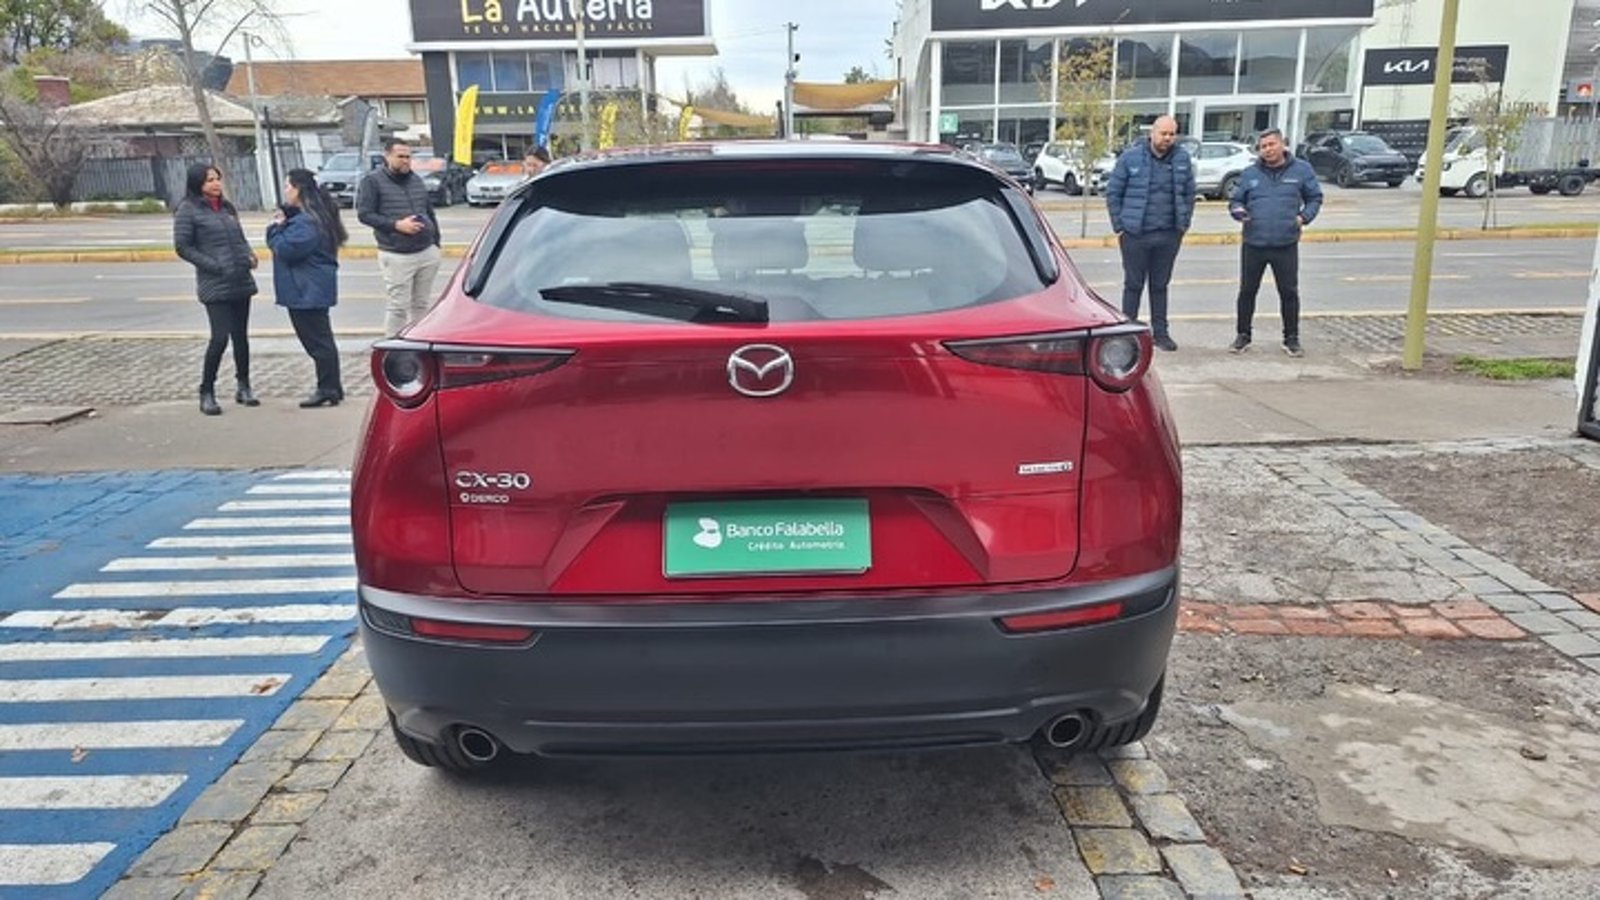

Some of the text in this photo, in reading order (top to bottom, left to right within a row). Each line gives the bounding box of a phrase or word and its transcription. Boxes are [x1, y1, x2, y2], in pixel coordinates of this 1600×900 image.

[461, 0, 502, 23] La
[464, 25, 481, 34] TE
[492, 24, 510, 34] LO
[1384, 59, 1430, 73] KIA
[455, 470, 531, 490] CX-30
